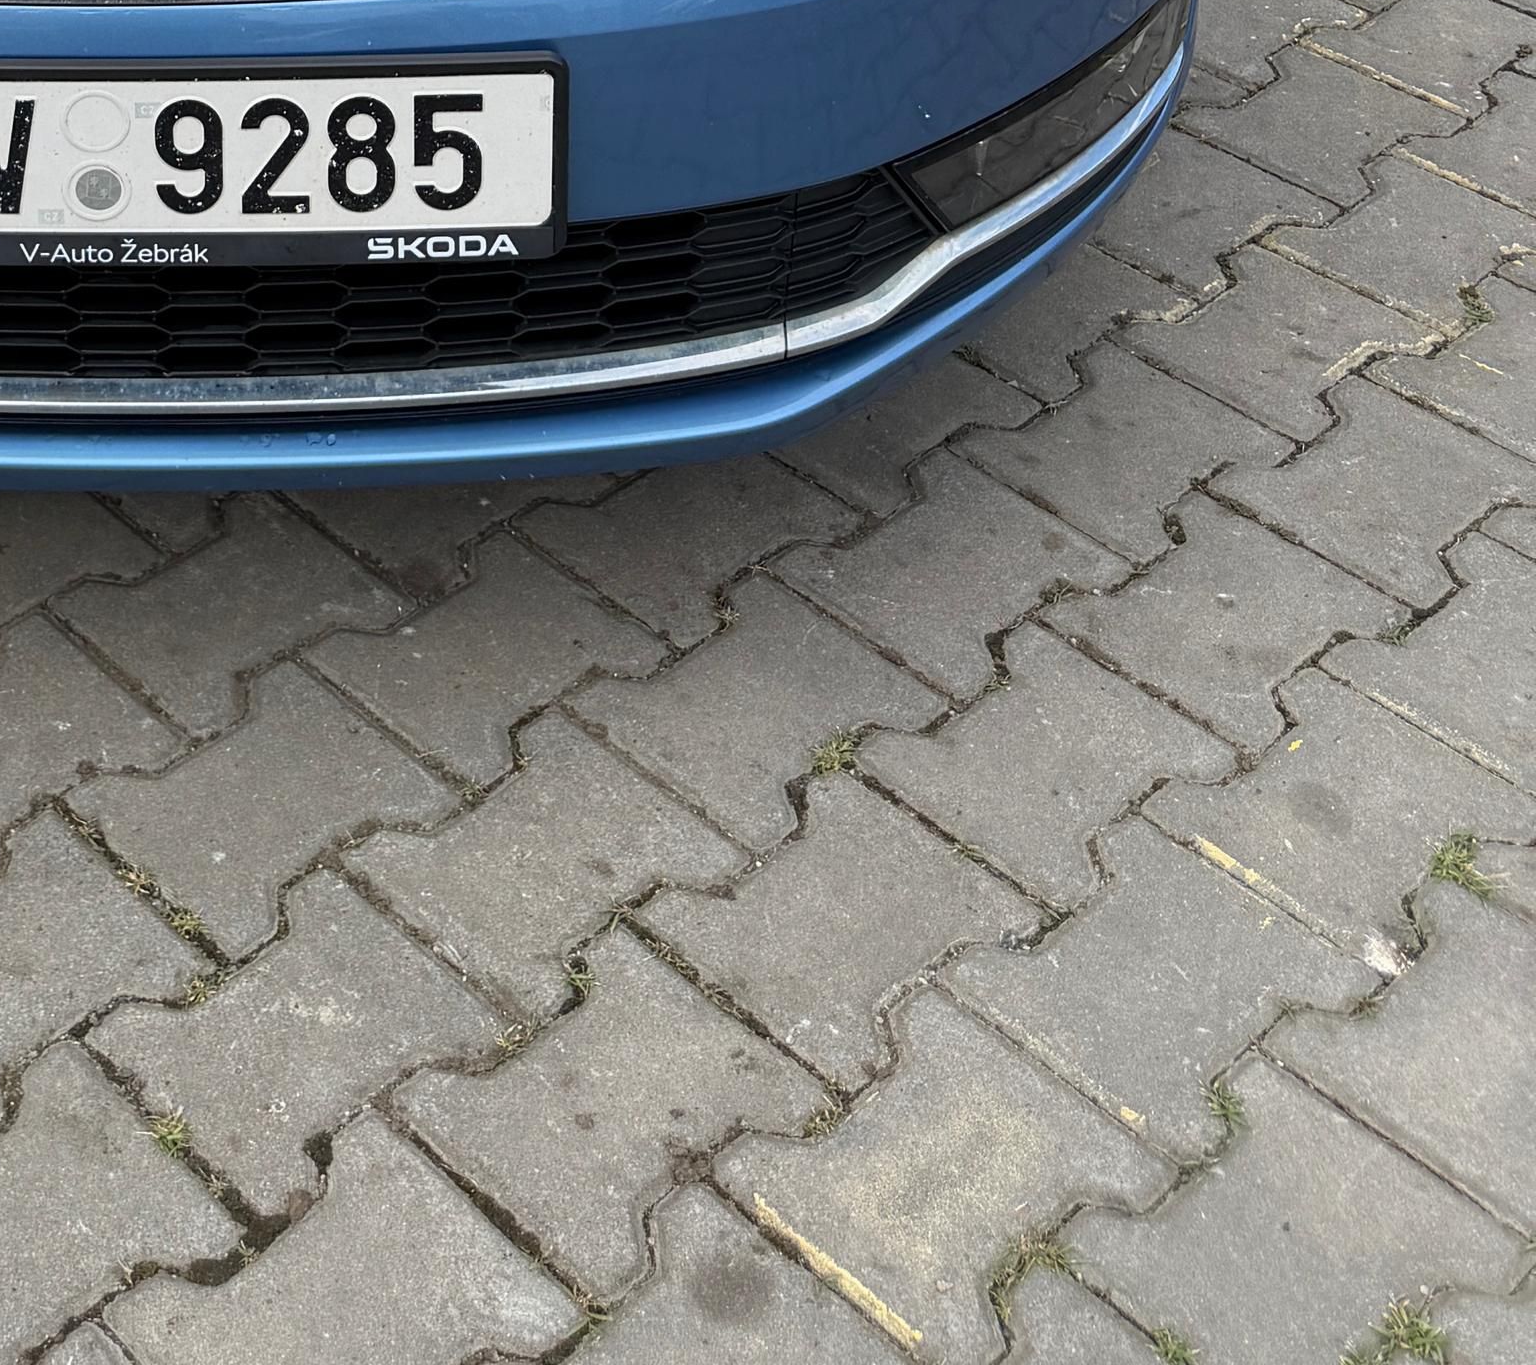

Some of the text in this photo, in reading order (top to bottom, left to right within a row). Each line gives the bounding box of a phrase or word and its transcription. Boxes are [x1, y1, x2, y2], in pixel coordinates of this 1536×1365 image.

[155, 94, 483, 214] 9285
[19, 238, 209, 264] V-Auto Žebrák
